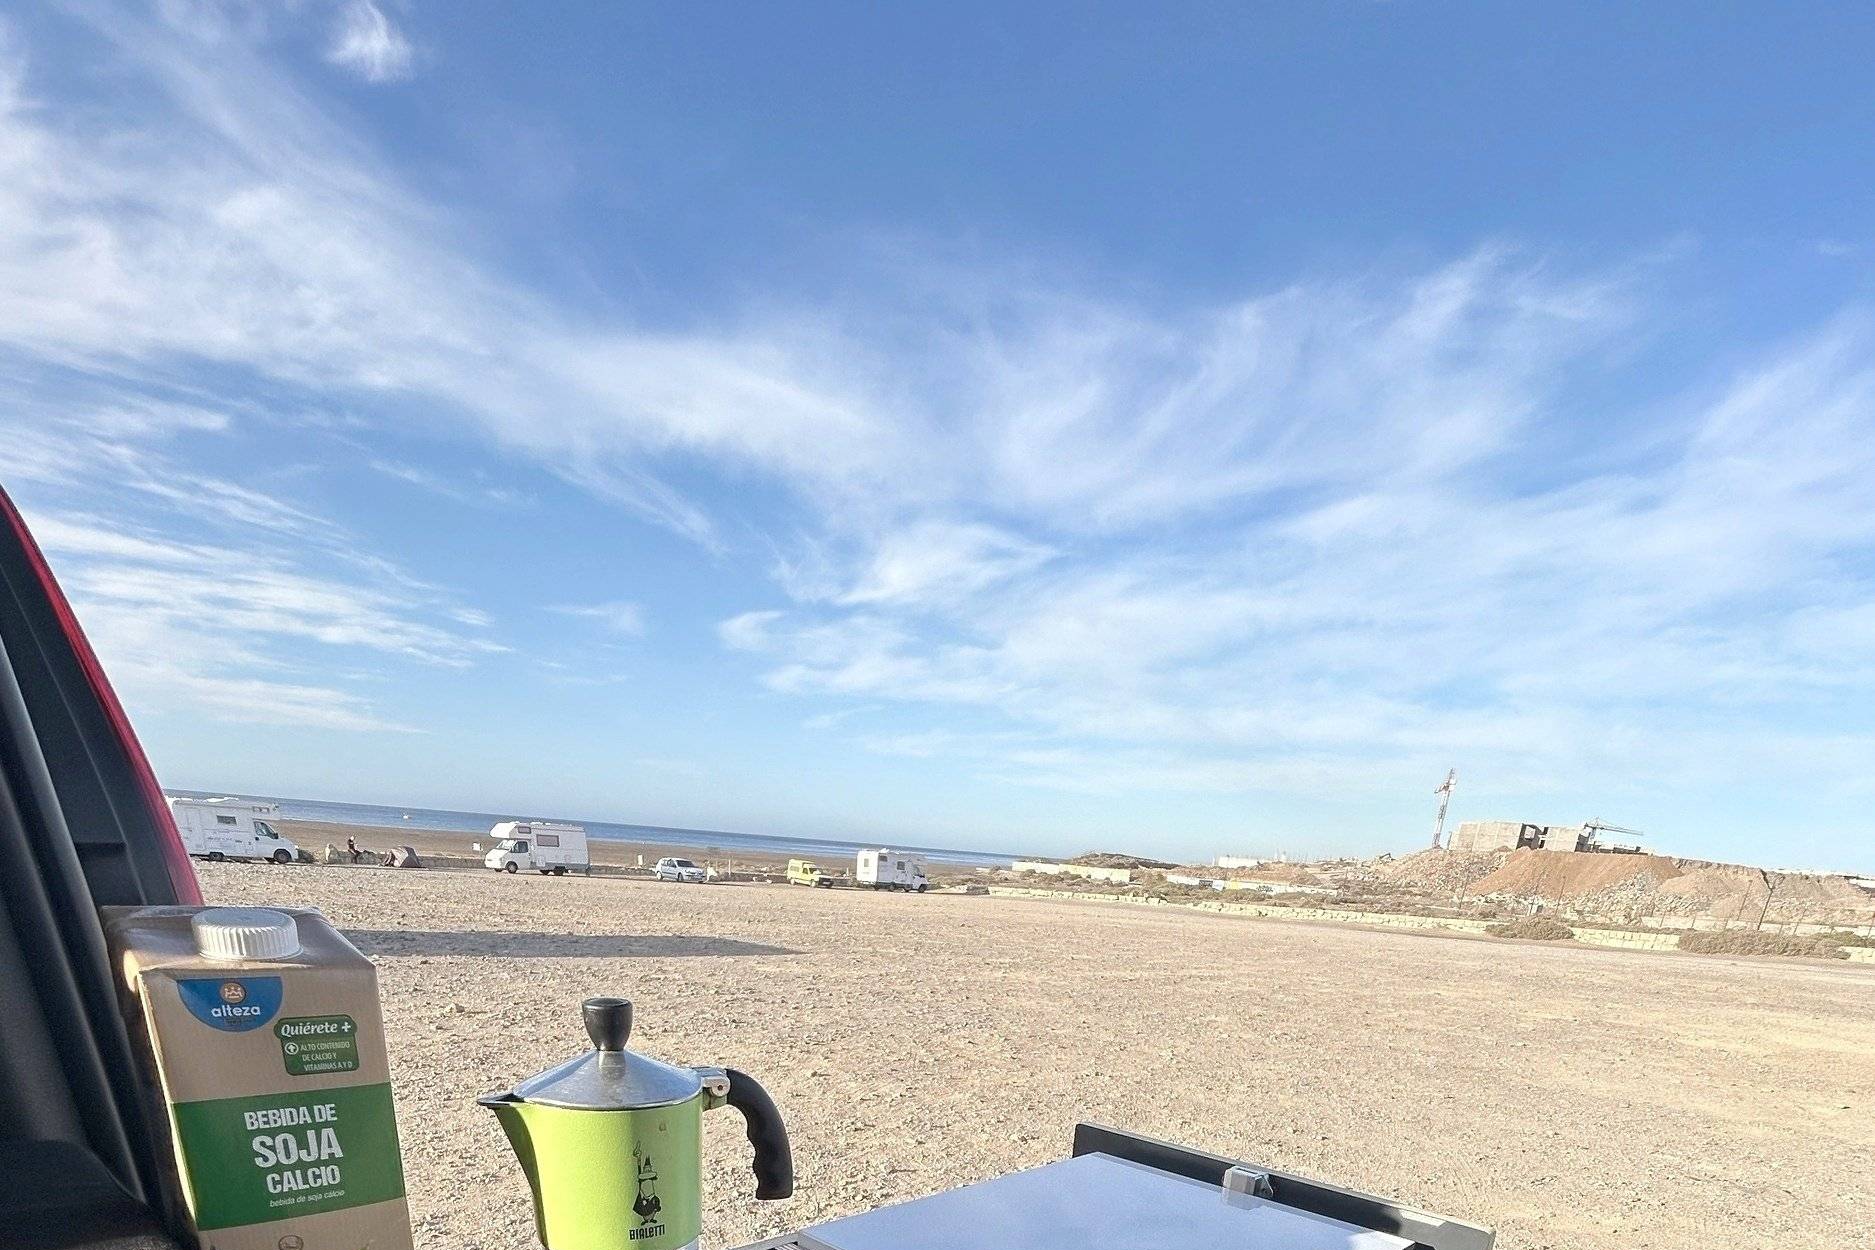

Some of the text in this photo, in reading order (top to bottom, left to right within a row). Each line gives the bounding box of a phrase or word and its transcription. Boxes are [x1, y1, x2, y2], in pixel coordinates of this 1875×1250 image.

[211, 1004, 261, 1017] alteza
[281, 1022, 338, 1037] Quiérete
[300, 1041, 351, 1051] ALTO CONTENIDO
[302, 1053, 311, 1061] DE
[311, 1052, 332, 1061] CALCIO
[304, 1062, 337, 1071] VITAMINAS
[244, 1103, 338, 1130] BEBIDA DE
[252, 1127, 344, 1168] SOJA
[266, 1165, 341, 1194] CALCIO
[269, 1197, 295, 1207] bebida
[307, 1193, 322, 1202] soja
